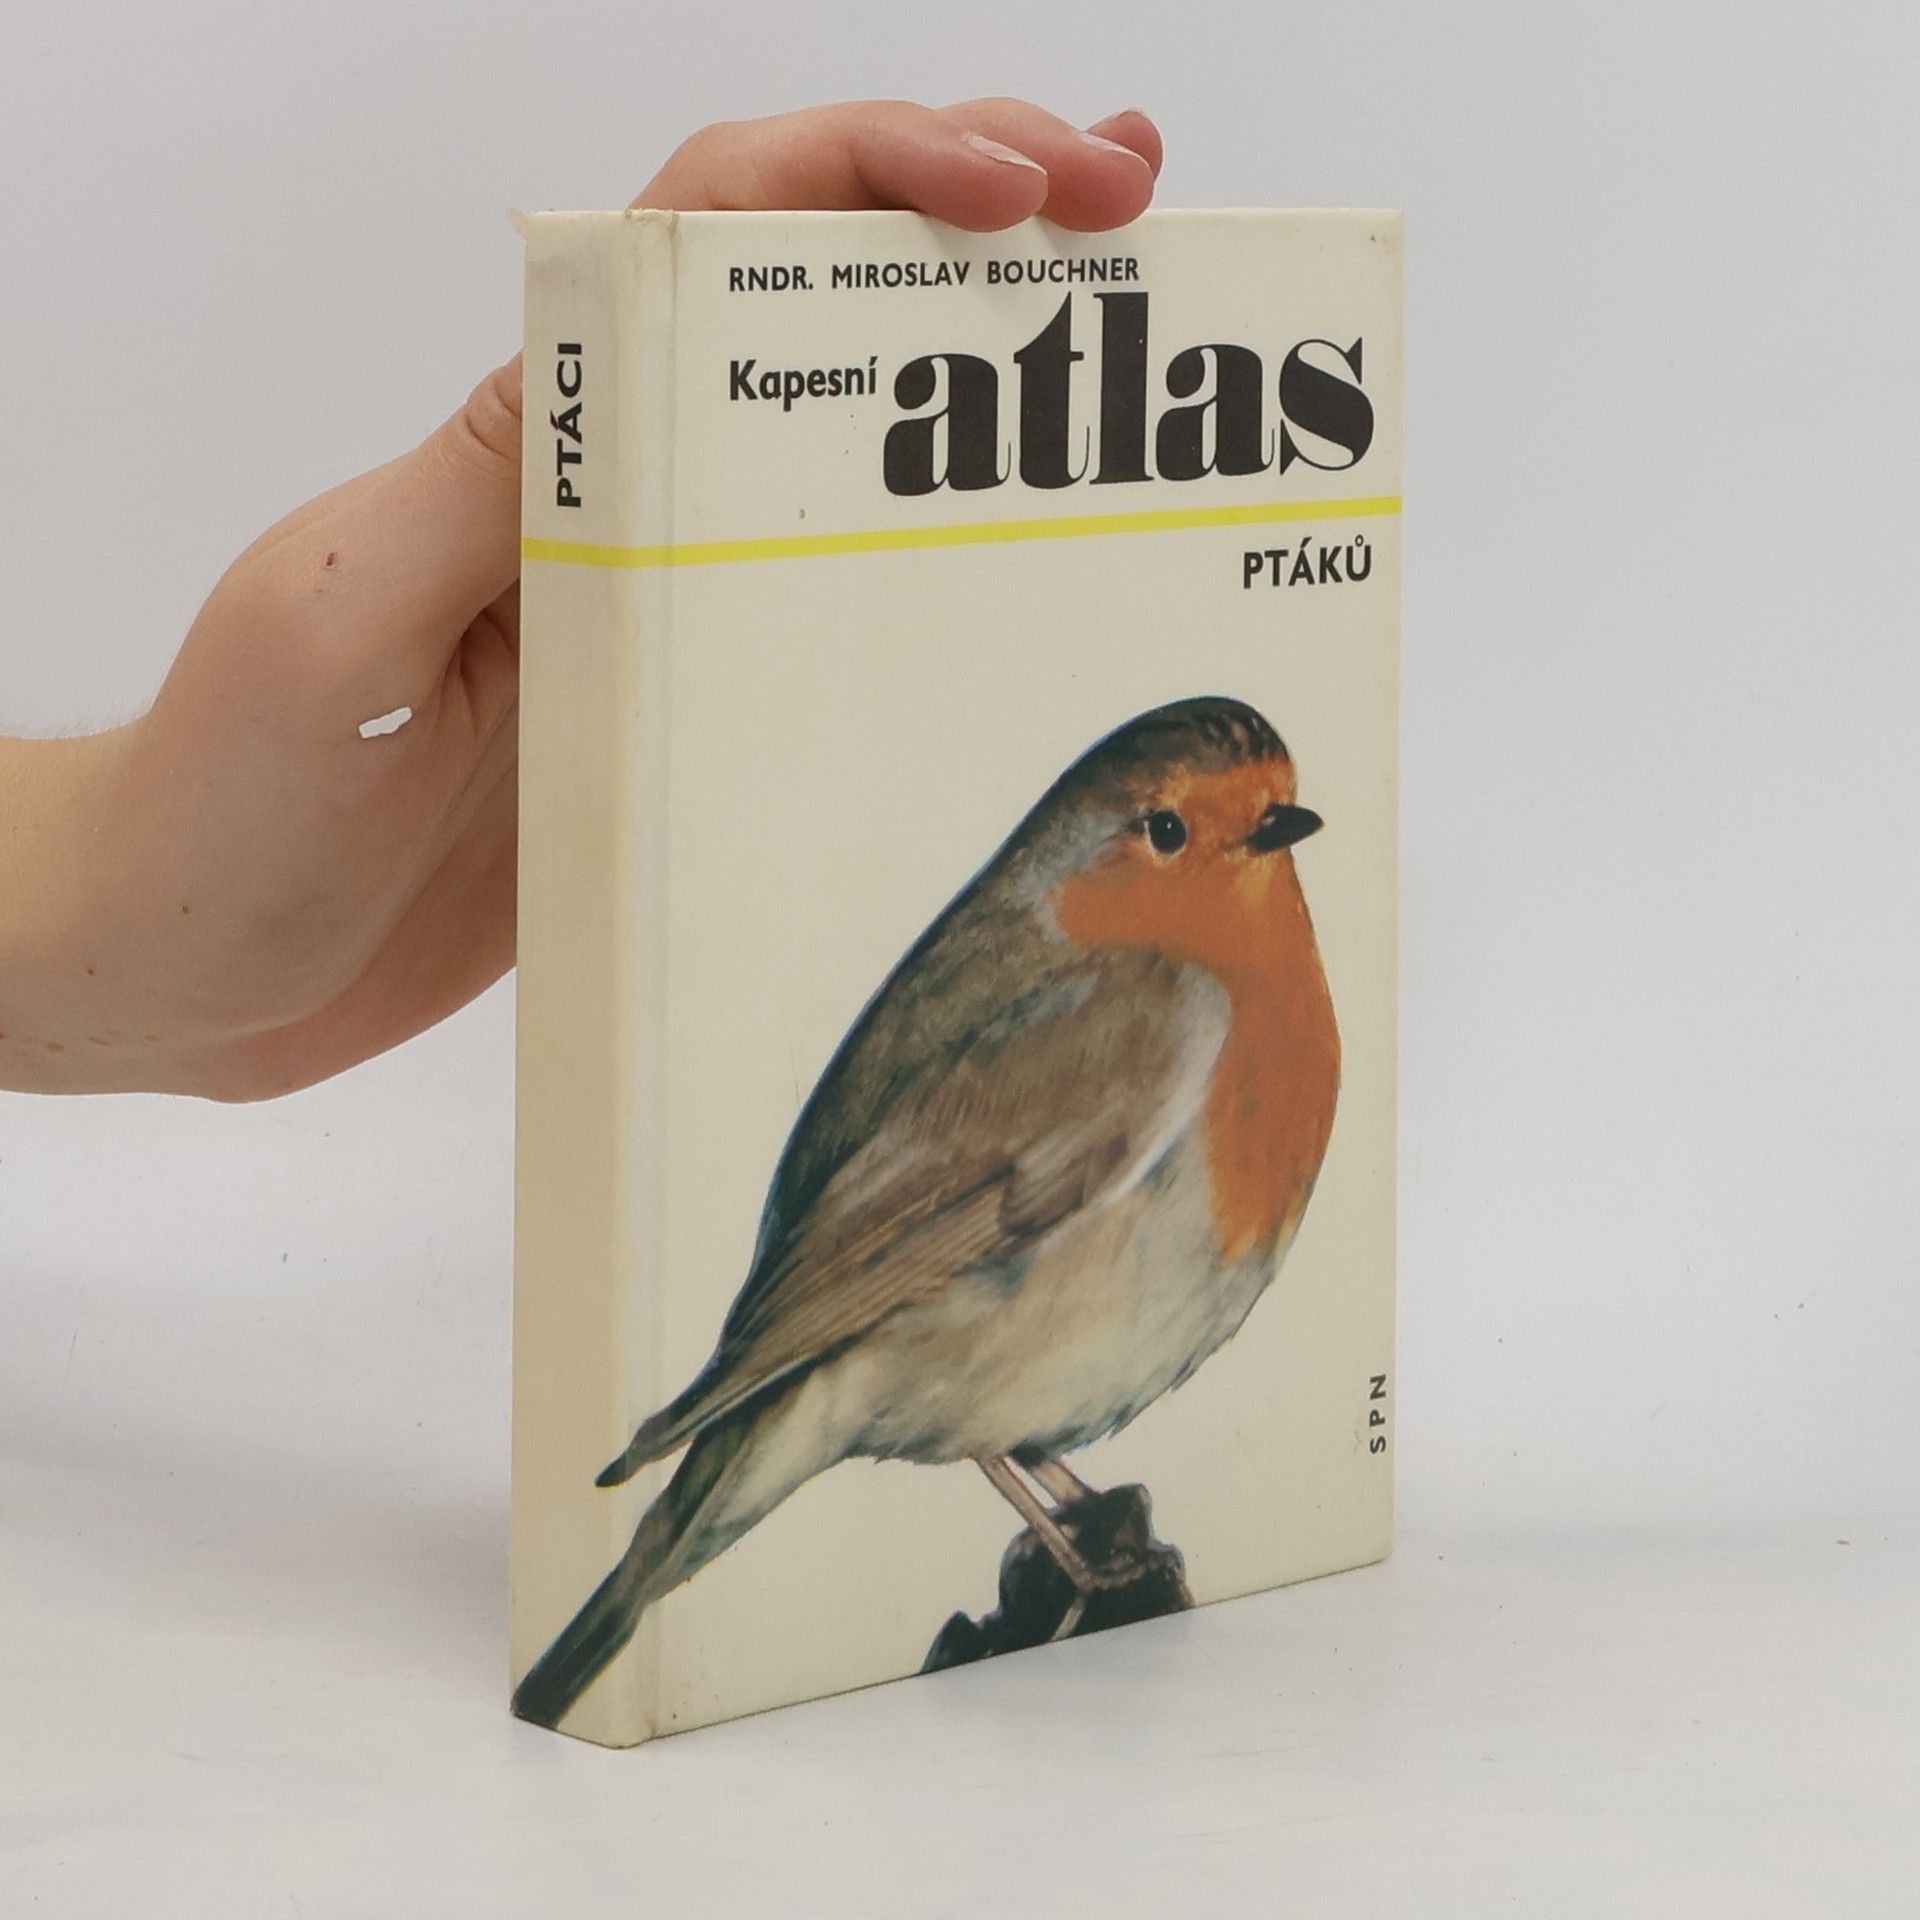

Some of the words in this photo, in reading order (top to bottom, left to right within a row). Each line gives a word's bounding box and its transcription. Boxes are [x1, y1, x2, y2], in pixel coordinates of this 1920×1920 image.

[729, 265, 814, 292] RNDR.
[831, 261, 971, 289] MIROSLAV
[986, 257, 1140, 285] BOUCHNER
[550, 342, 583, 509] PTÁCI
[729, 356, 878, 412] Kapesní
[883, 291, 1375, 497] atlas
[1243, 534, 1372, 589] PTÁKŮ
